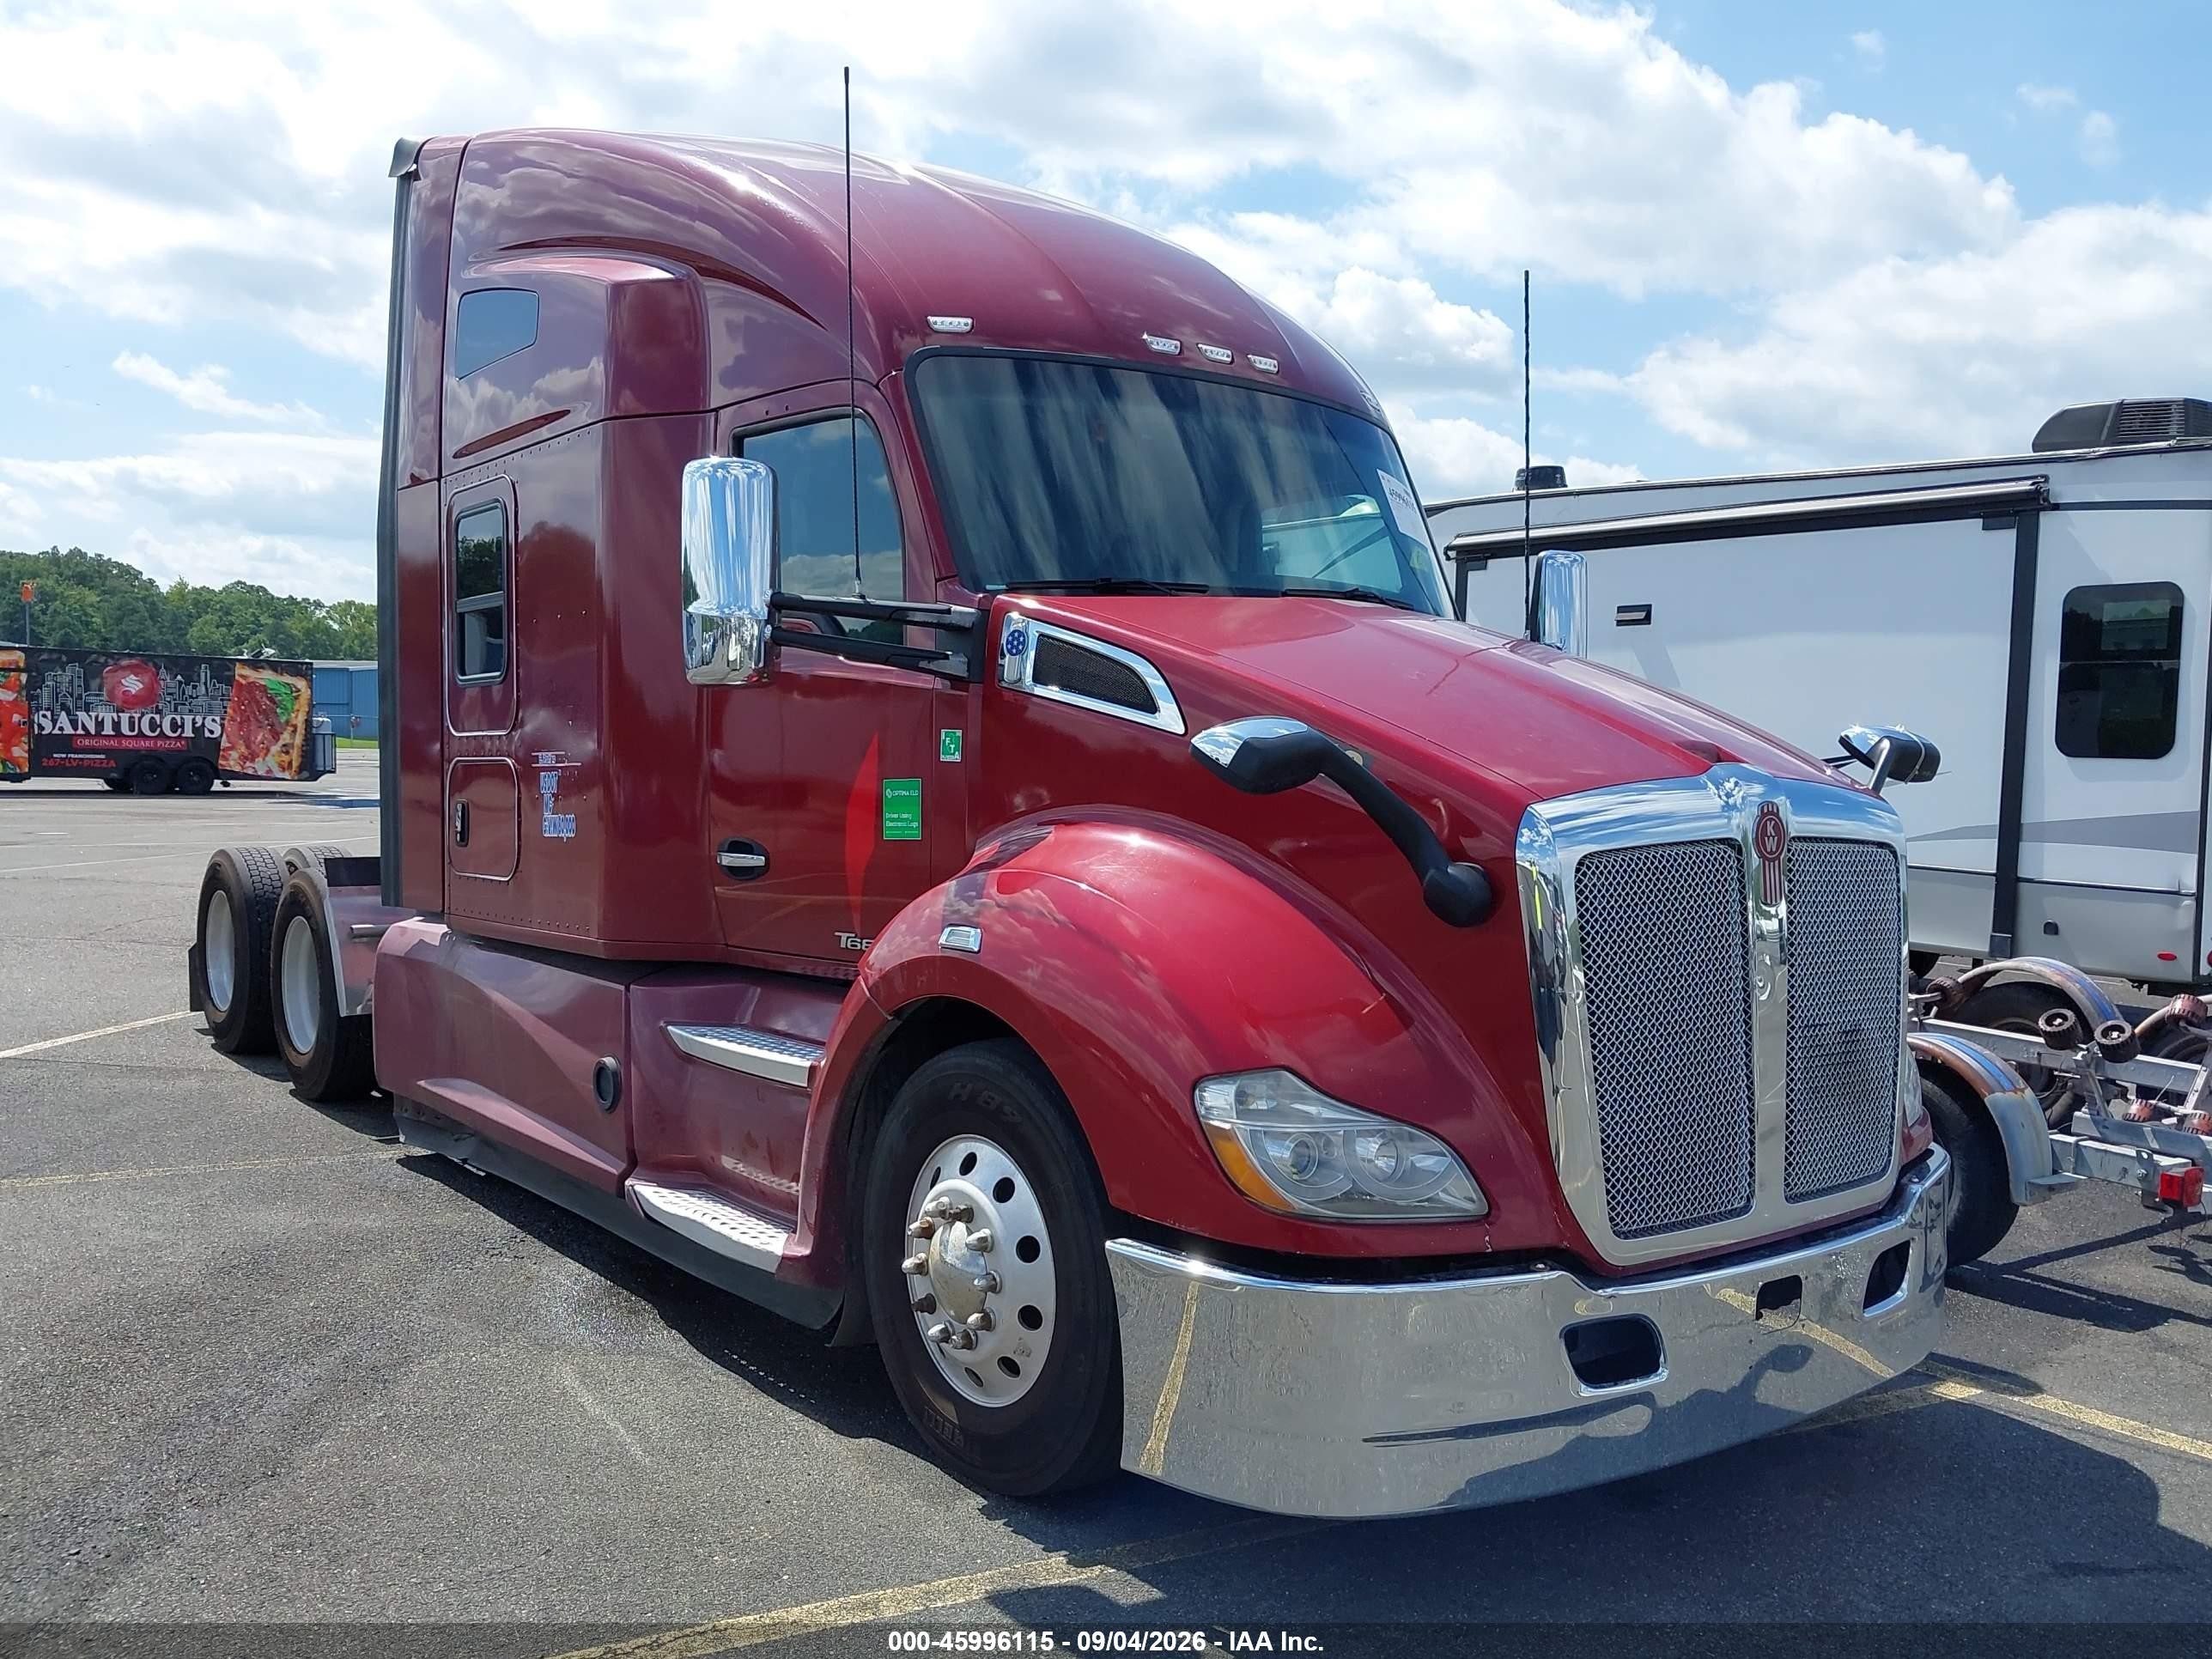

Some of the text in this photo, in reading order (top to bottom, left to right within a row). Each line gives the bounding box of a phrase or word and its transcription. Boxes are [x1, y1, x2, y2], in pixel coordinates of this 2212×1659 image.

[34, 711, 222, 738] SANTUCCI'S
[77, 738, 118, 747] ORIGINAL
[122, 739, 155, 748] SQUARE
